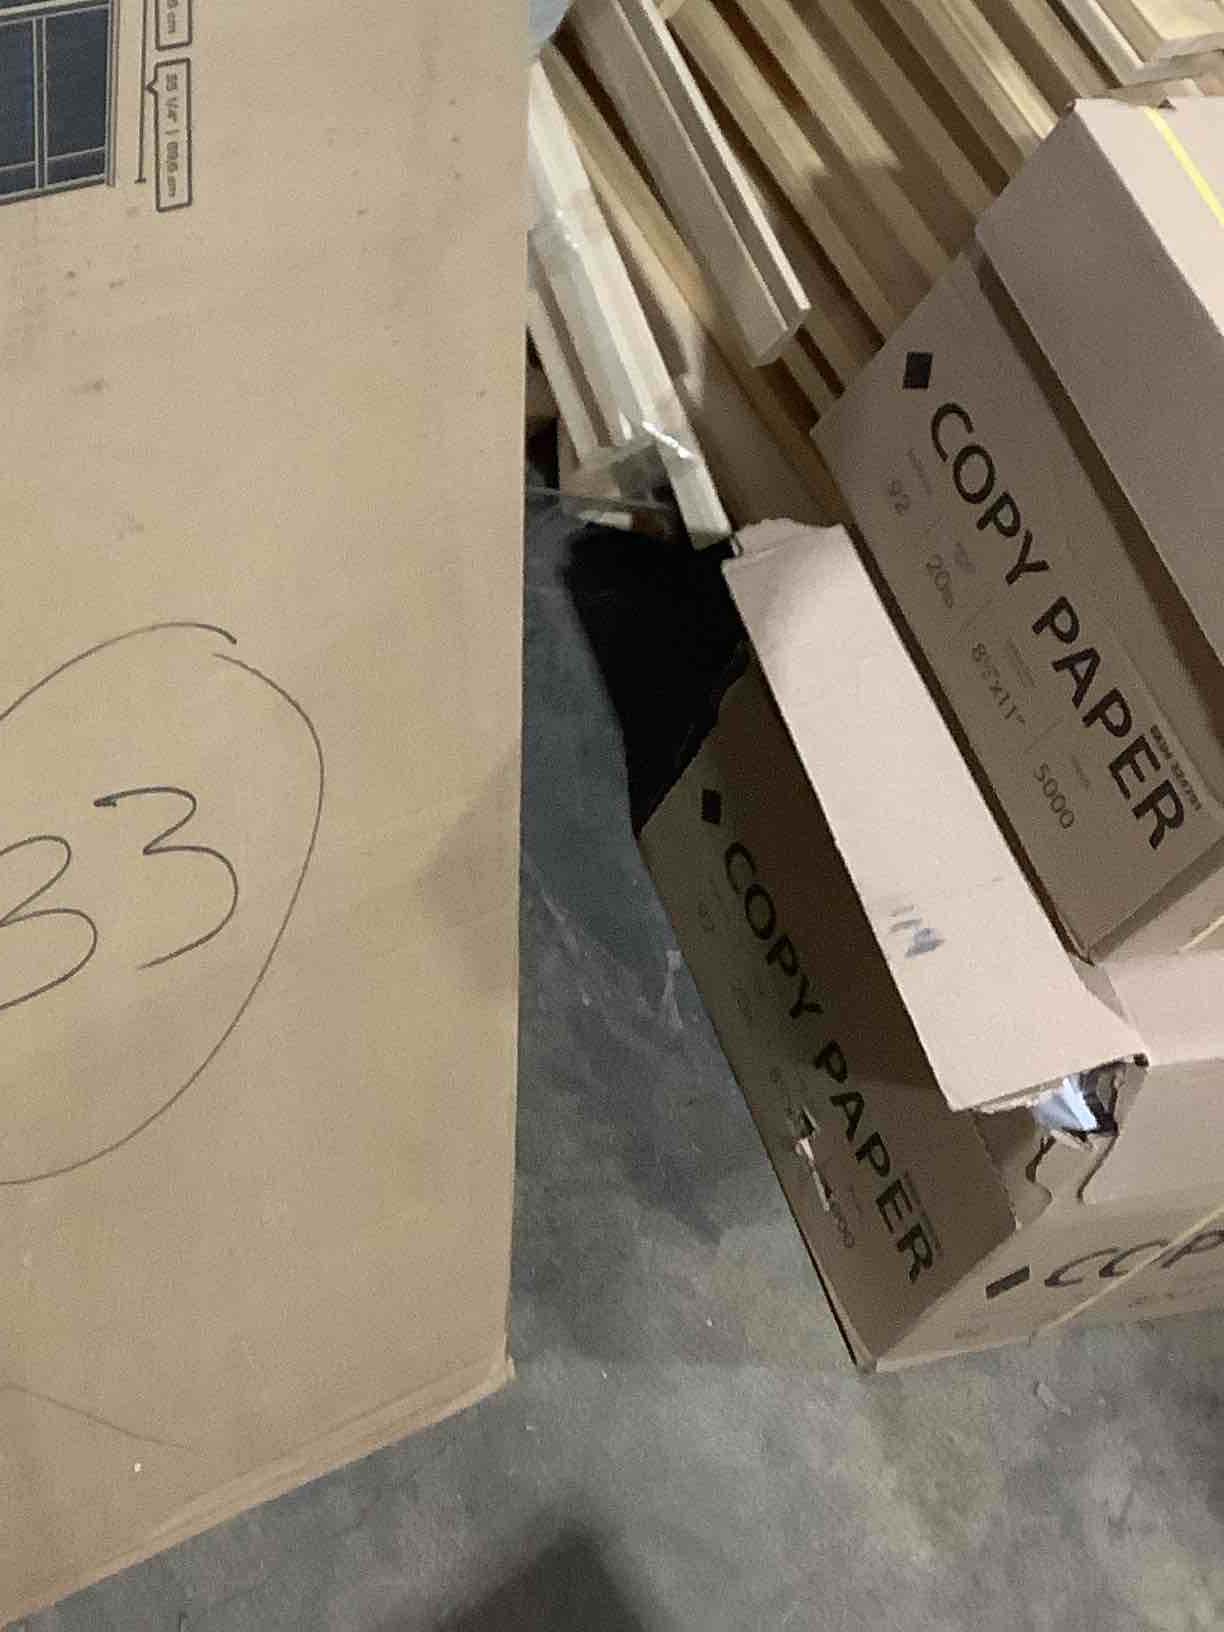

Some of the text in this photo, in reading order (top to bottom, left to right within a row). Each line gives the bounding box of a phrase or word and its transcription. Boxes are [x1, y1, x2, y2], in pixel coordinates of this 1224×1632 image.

[930, 402, 1186, 849] COPY PAPER
[1032, 762, 1075, 830] 5000
[723, 841, 937, 1284] COPY PAPER
